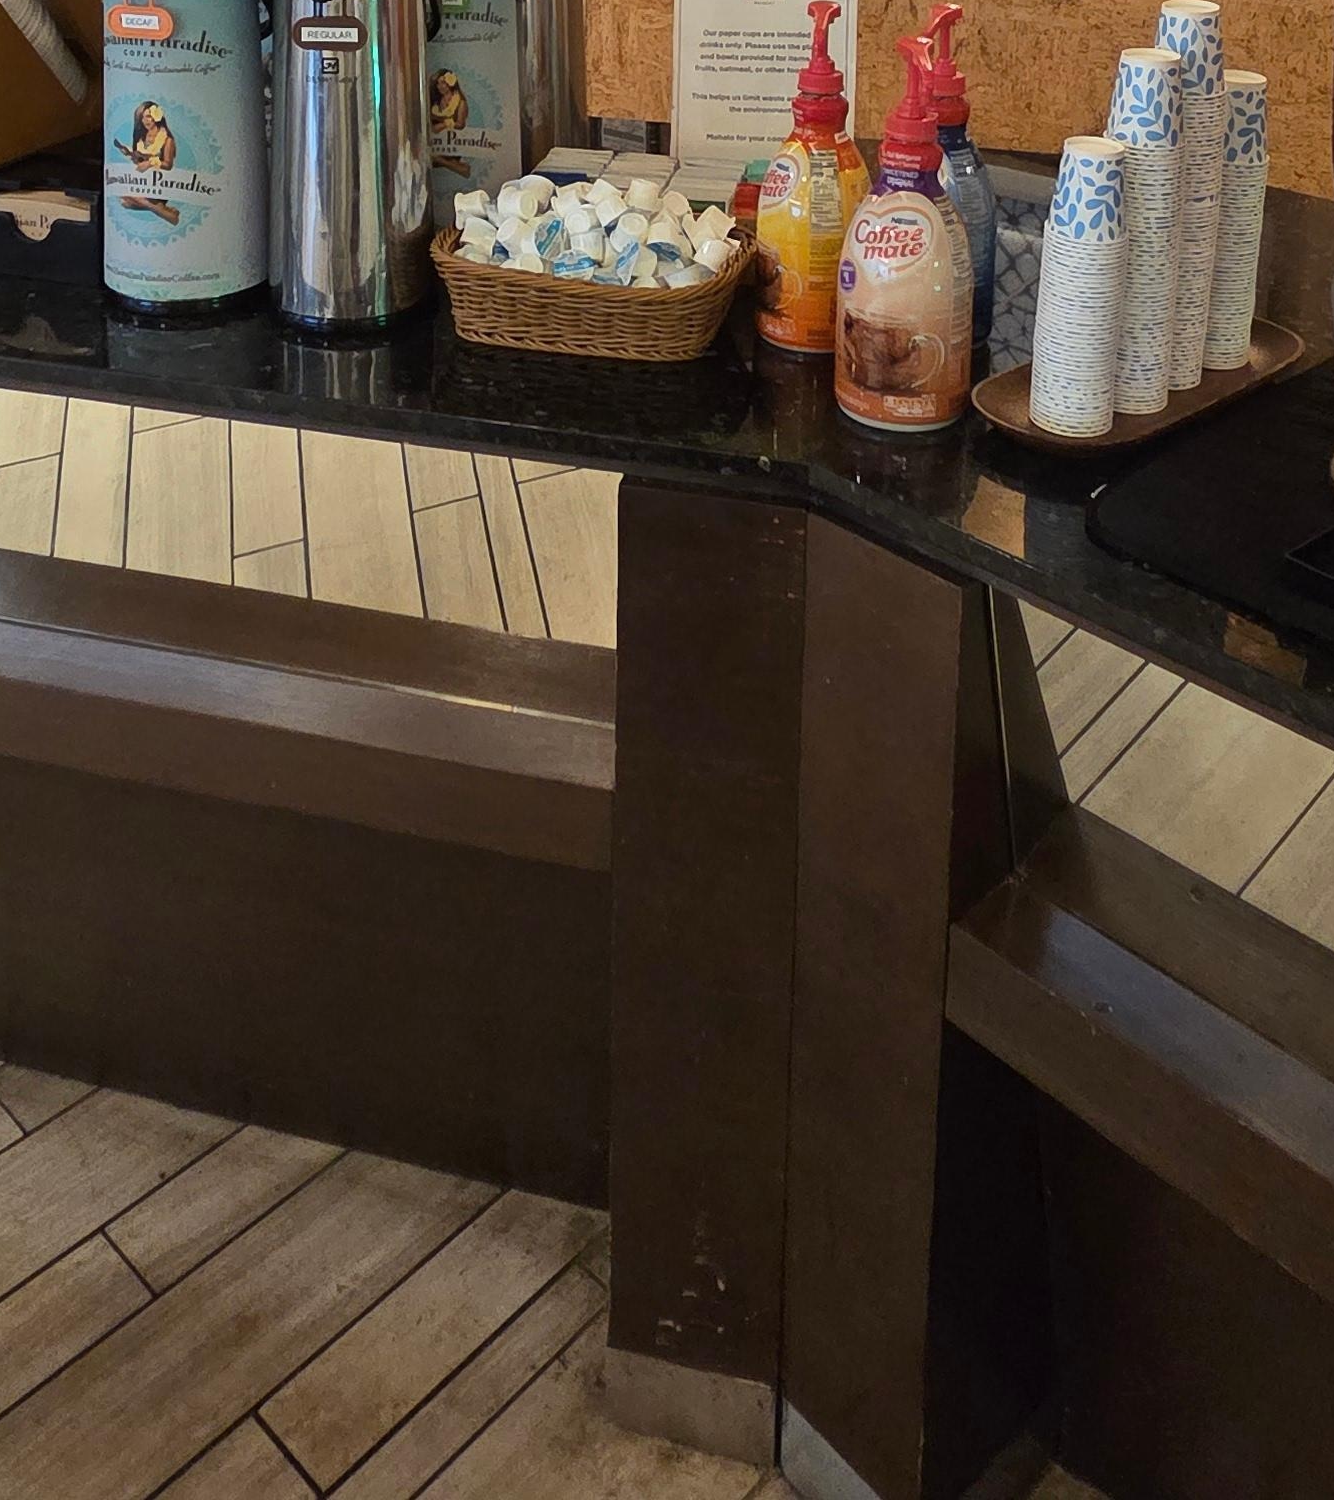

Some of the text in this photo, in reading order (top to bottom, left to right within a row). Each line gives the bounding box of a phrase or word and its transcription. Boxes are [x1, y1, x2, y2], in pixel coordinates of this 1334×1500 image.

[124, 17, 153, 27] DECAF
[307, 30, 353, 39] REGULAR
[123, 49, 162, 58] COFFEE
[447, 130, 496, 150] Paradise
[152, 170, 215, 196] Paradise
[764, 169, 791, 185] ffee
[130, 186, 163, 195] COFFEE
[854, 219, 924, 245] Coffee
[863, 242, 924, 260] mate
